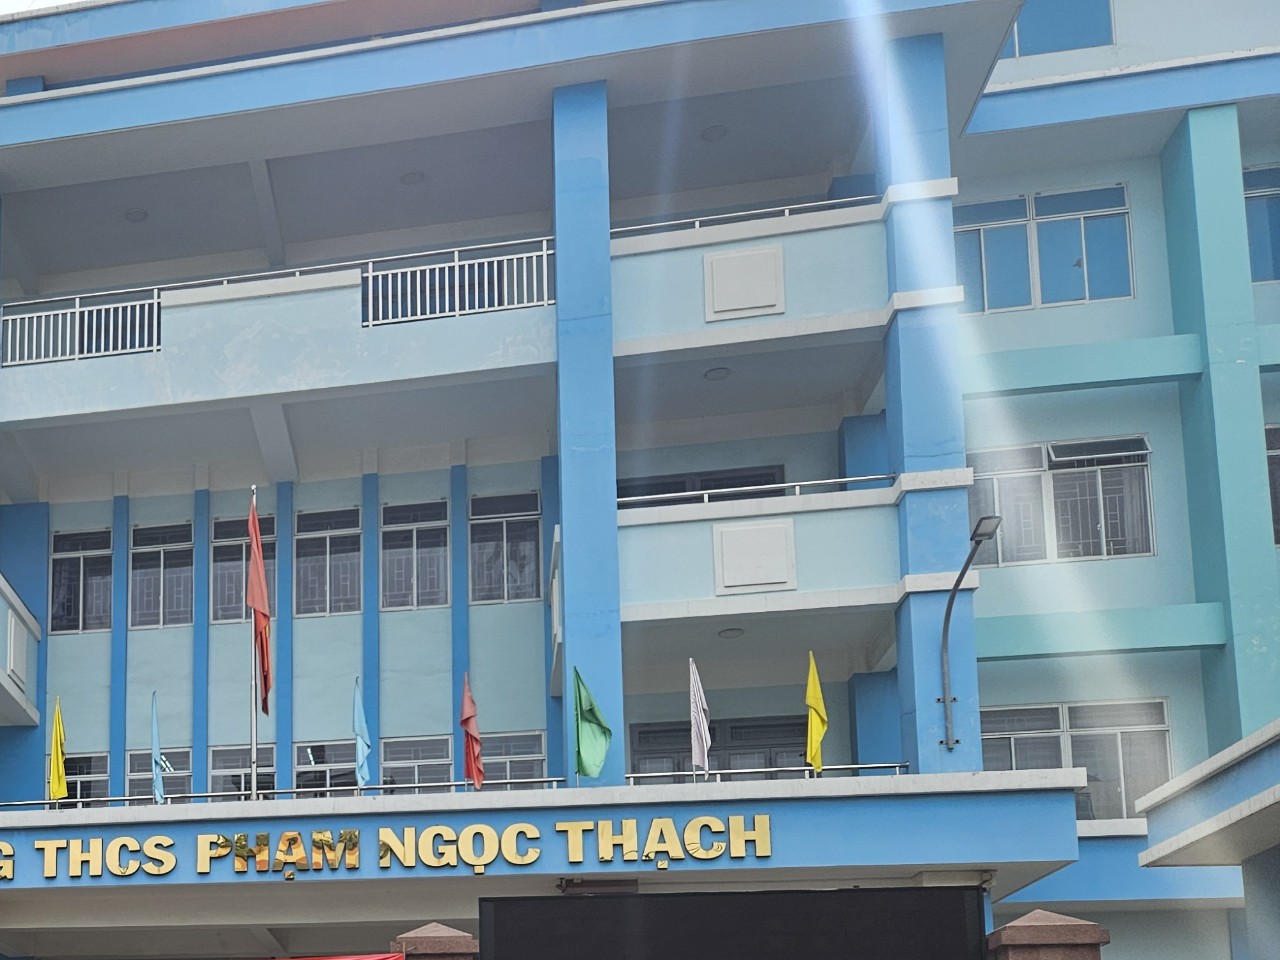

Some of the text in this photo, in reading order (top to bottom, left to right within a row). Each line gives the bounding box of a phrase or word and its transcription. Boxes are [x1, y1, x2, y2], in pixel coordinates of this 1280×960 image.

[34, 835, 177, 878] THCS
[197, 829, 360, 879] PHẠM
[379, 822, 541, 875] NGỌC
[555, 814, 771, 868] THẠCH
